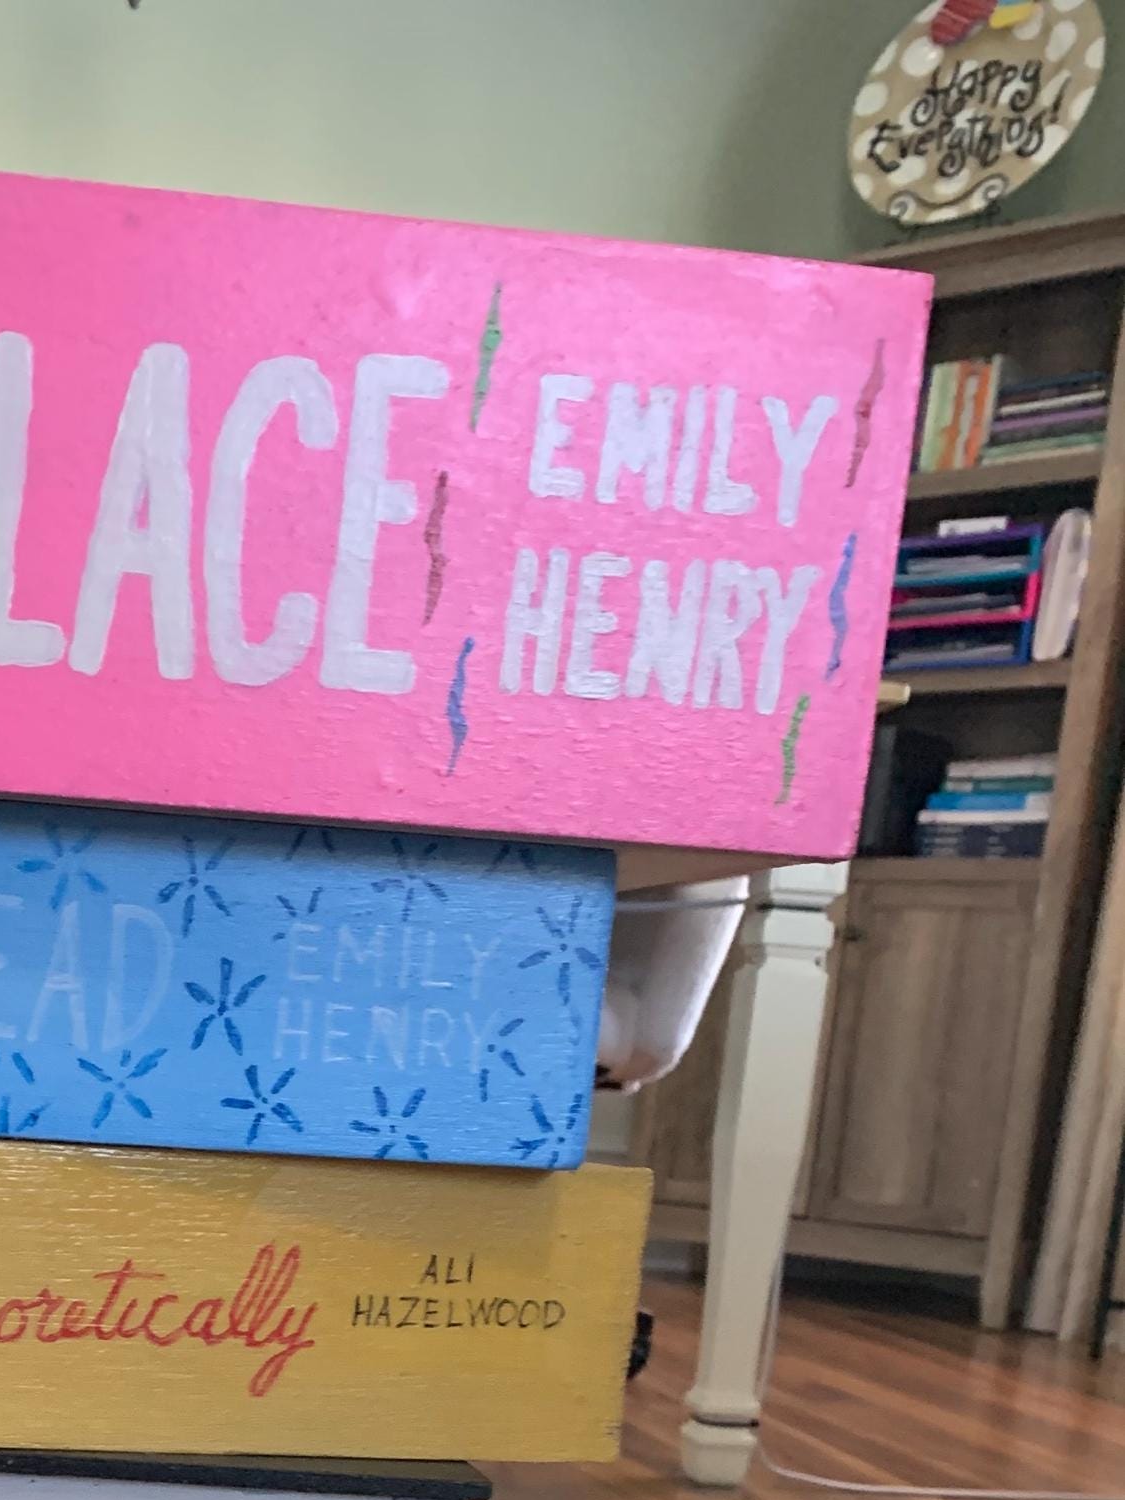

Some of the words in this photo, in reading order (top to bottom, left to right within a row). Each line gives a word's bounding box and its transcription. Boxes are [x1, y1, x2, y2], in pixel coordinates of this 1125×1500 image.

[910, 59, 1043, 127] Happy
[527, 373, 841, 528] EMILY
[498, 548, 822, 716] HENRY
[286, 920, 503, 1001] EMILY
[272, 998, 502, 1075] HENRY
[420, 1253, 476, 1286] ALI
[351, 1294, 566, 1331] HAZELWOOD
